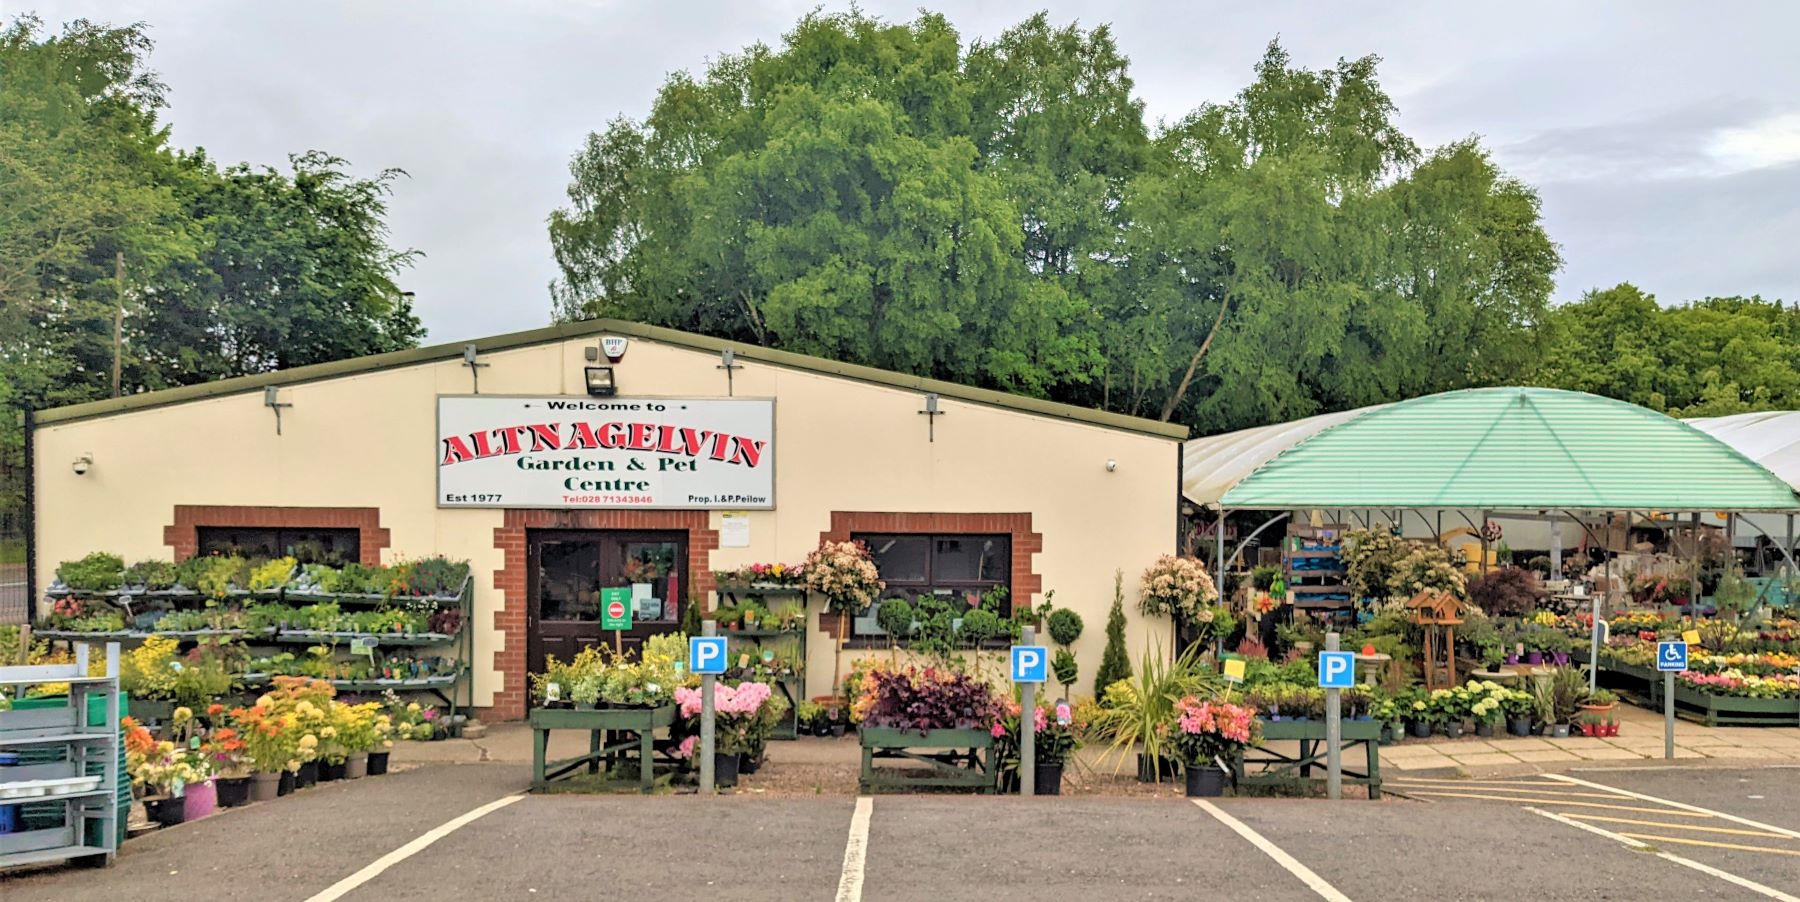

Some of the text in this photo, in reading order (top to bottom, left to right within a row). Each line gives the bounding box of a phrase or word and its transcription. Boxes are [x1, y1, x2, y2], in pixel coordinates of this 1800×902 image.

[546, 401, 667, 412] Welcome to
[515, 456, 697, 472] Garden & Pet
[563, 476, 650, 492] Centre
[446, 493, 503, 503] Est 1977
[562, 495, 653, 504] Tel:028 71343846
[688, 494, 713, 505] Prop.
[698, 642, 720, 669] P
[1018, 650, 1040, 678] P
[1326, 657, 1347, 683] P
